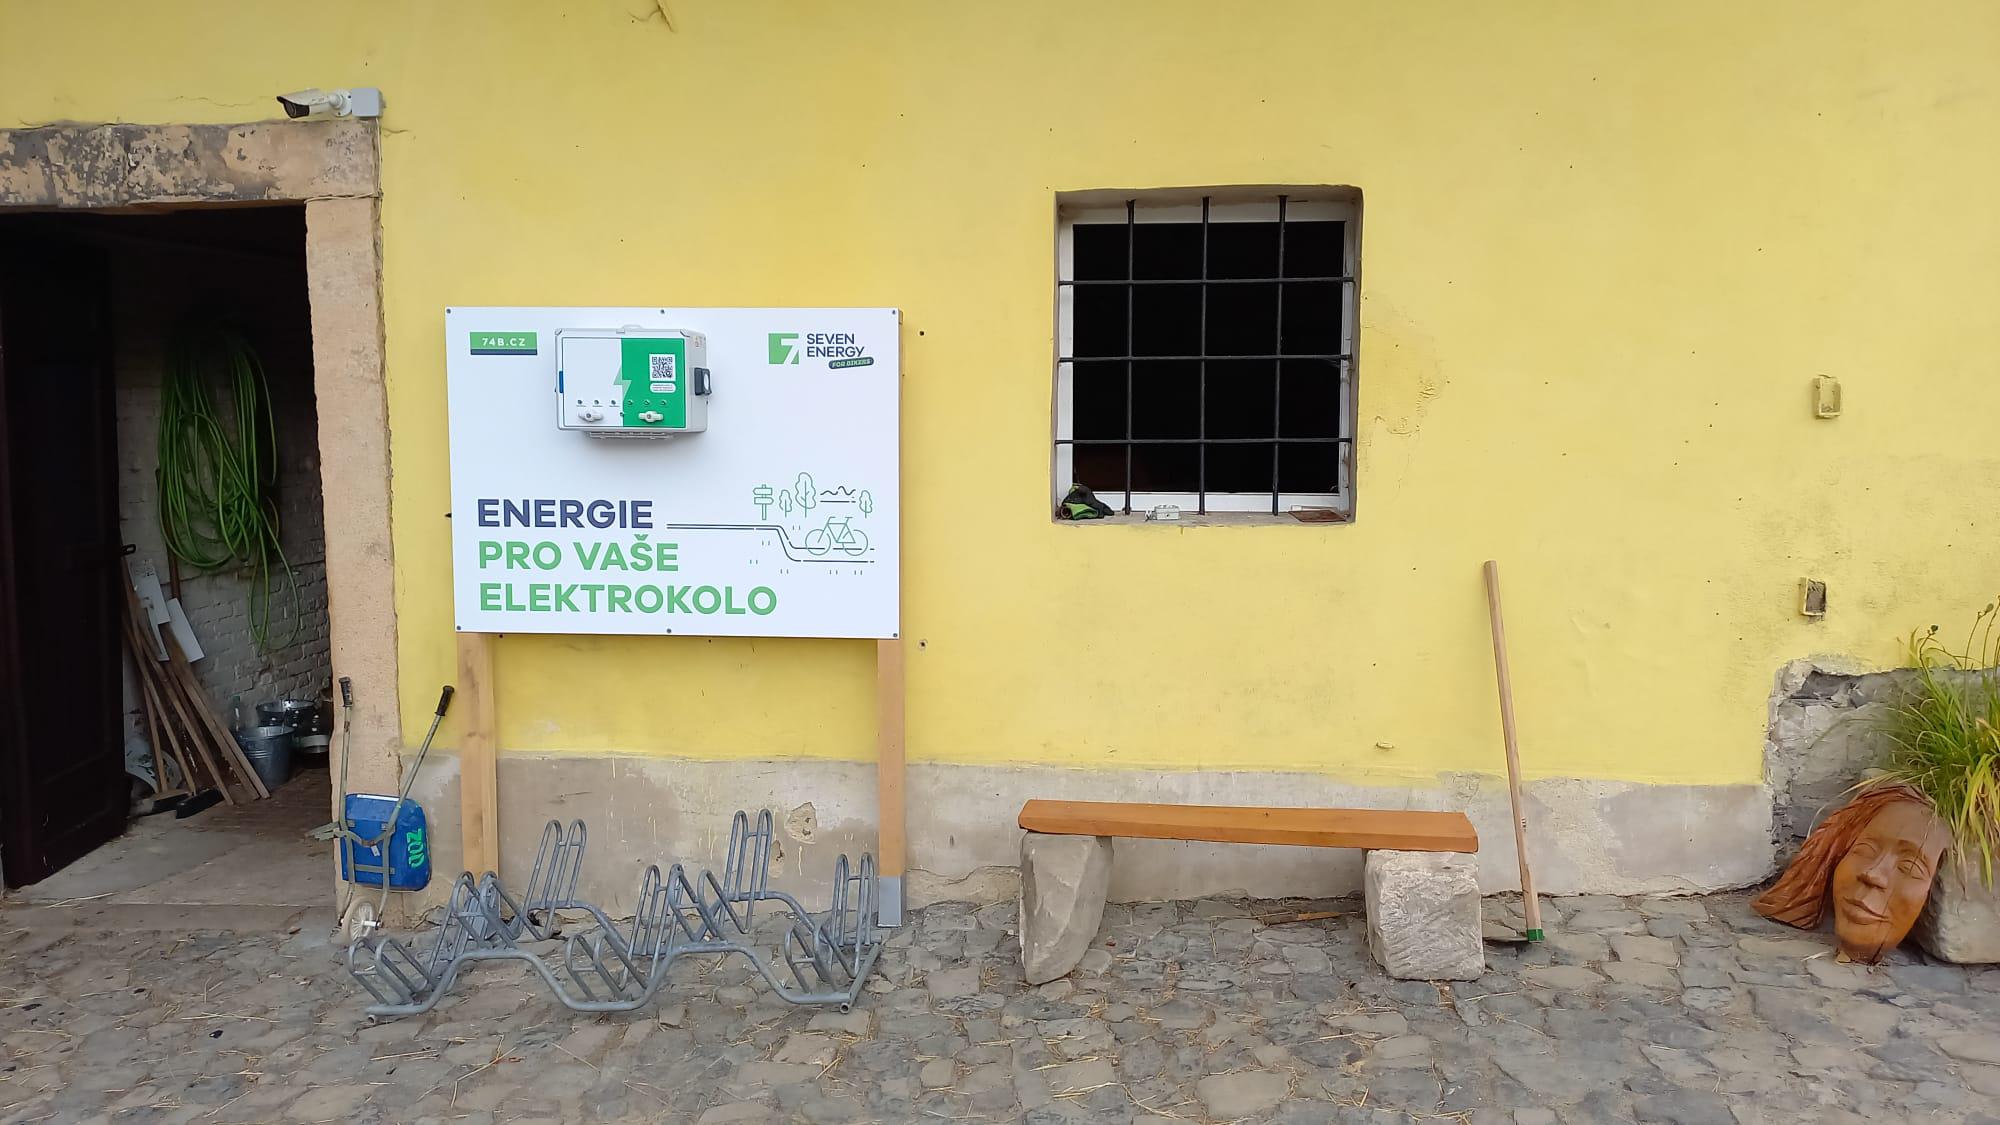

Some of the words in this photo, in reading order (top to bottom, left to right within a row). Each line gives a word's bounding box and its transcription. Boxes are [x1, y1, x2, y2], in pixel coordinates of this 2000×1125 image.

[481, 337, 526, 347] 74B.CZ
[806, 346, 865, 358] ENERGY
[478, 499, 654, 528] ENERGIE
[479, 541, 562, 570] PRO
[573, 534, 679, 572] VAŠE
[480, 582, 777, 616] ELEKTROKOLO
